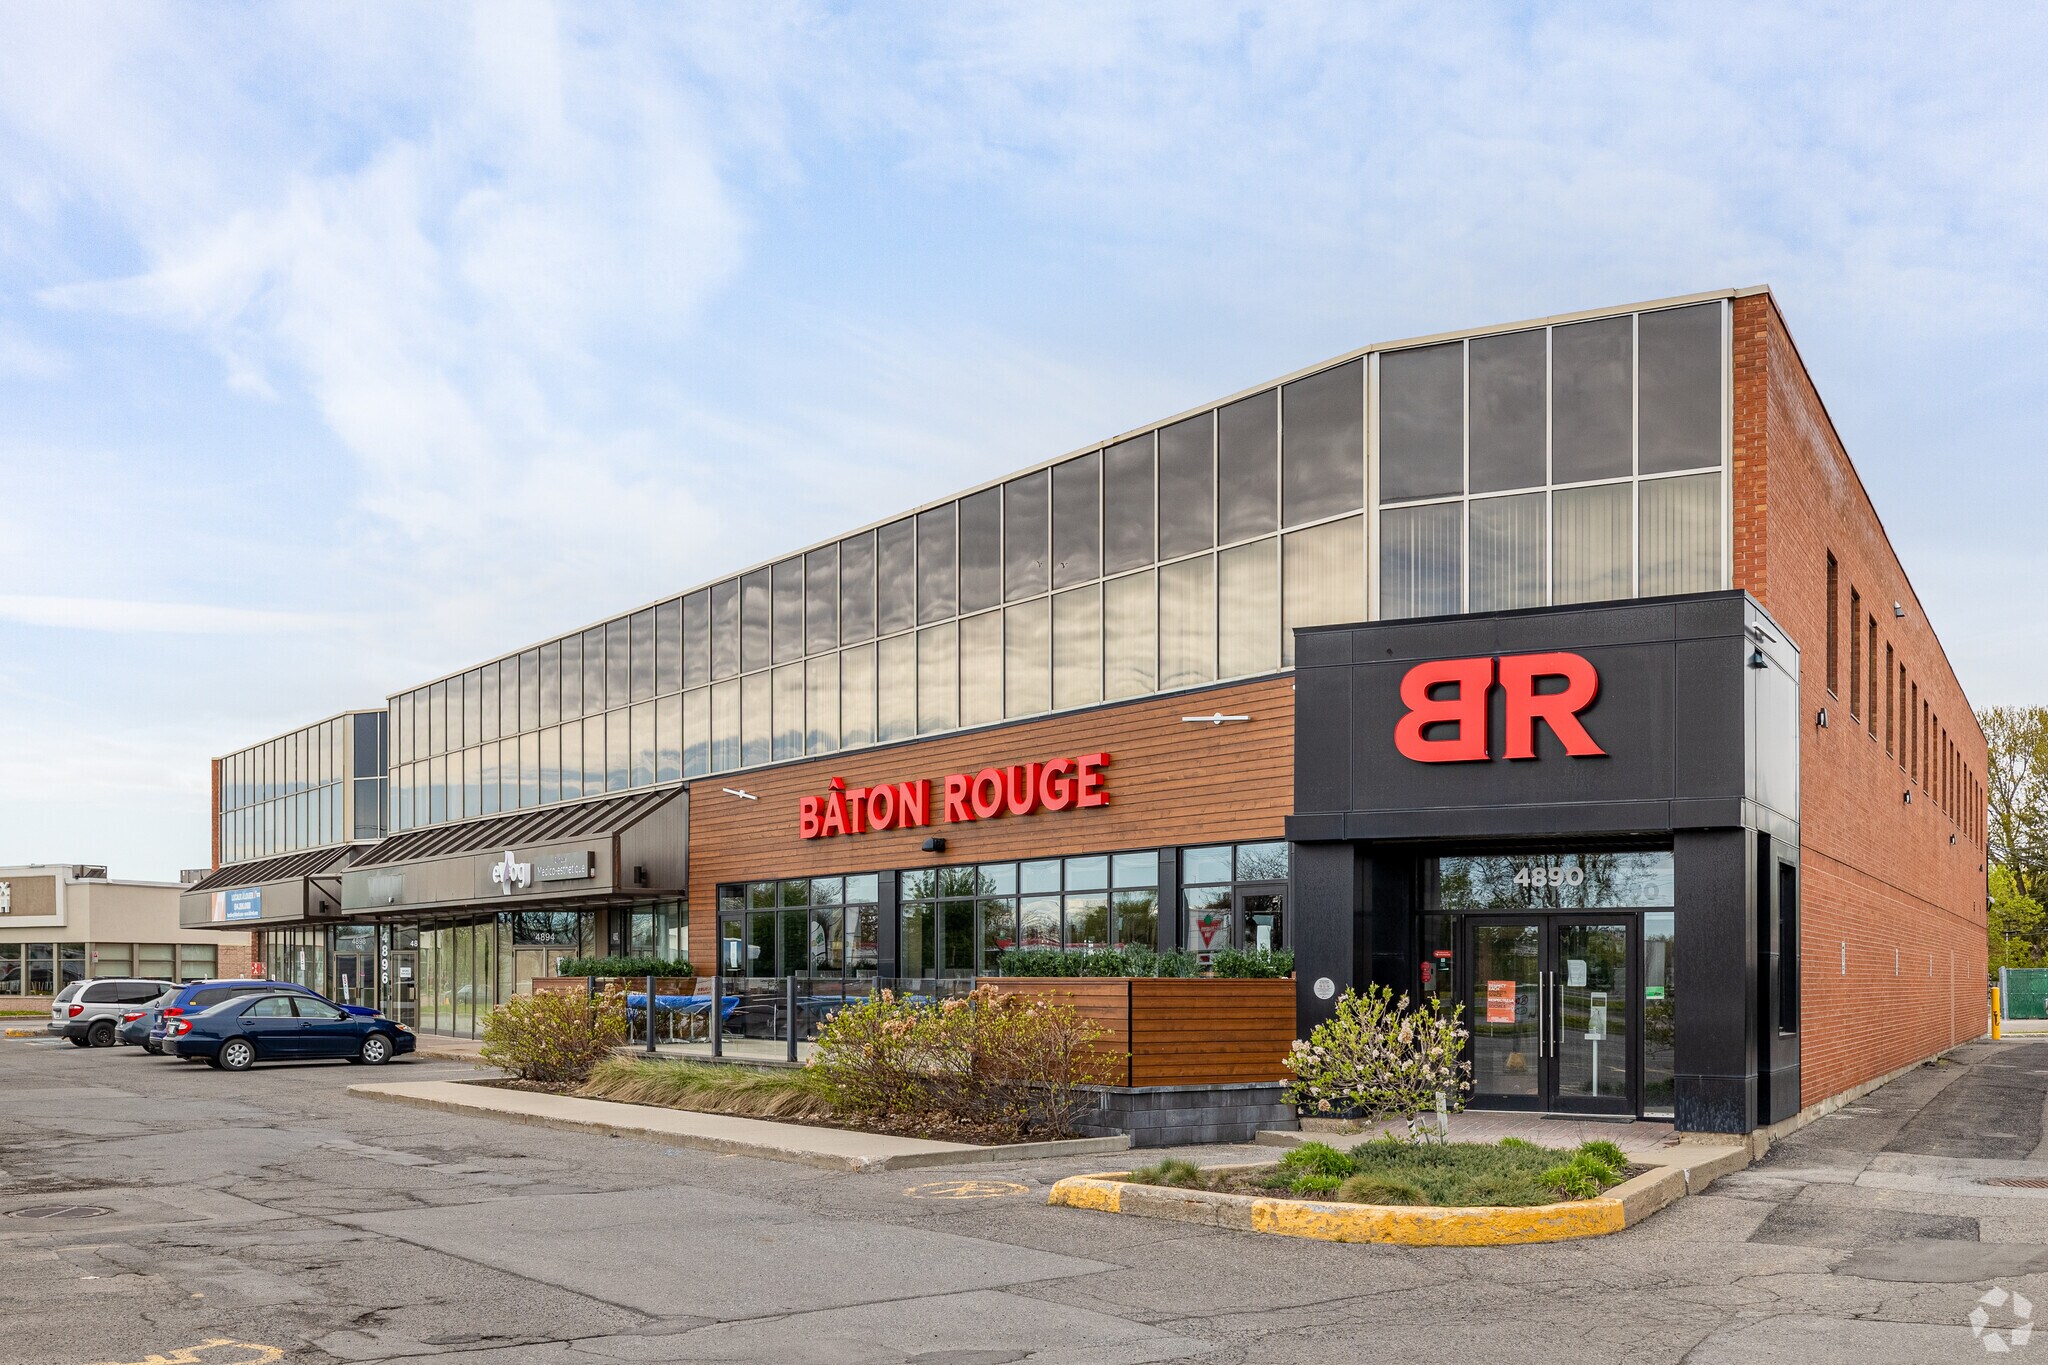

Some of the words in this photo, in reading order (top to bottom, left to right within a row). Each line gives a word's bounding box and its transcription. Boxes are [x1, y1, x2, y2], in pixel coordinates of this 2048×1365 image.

[1394, 652, 1607, 763] BR
[799, 776, 931, 840] BÂTON
[943, 752, 1111, 823] ROUGE
[1513, 866, 1584, 887] 4890
[535, 932, 556, 941] 4894
